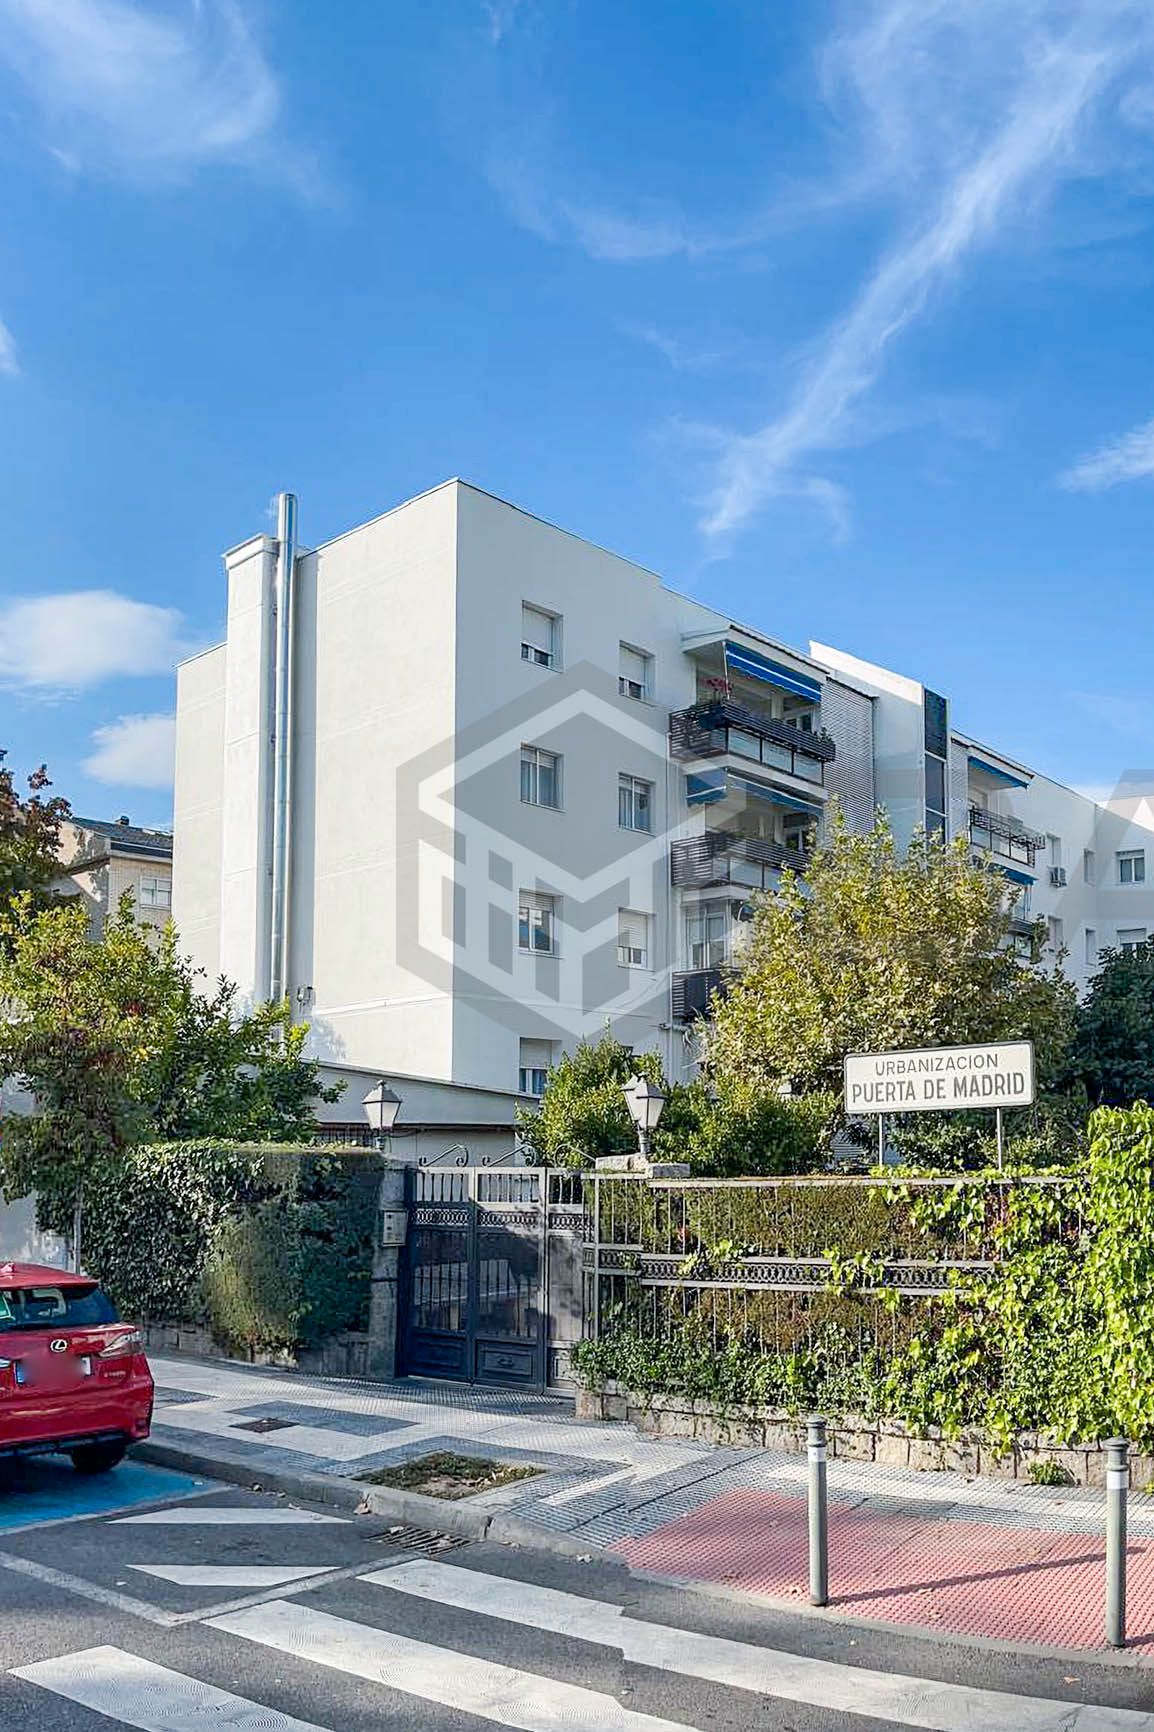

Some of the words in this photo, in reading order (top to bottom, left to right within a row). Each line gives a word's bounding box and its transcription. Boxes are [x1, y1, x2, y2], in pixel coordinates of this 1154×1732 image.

[875, 1053, 999, 1076] URBANIZACION
[852, 1079, 916, 1104] PUERTA
[923, 1078, 947, 1100] DE
[953, 1072, 1025, 1099] MADRID
